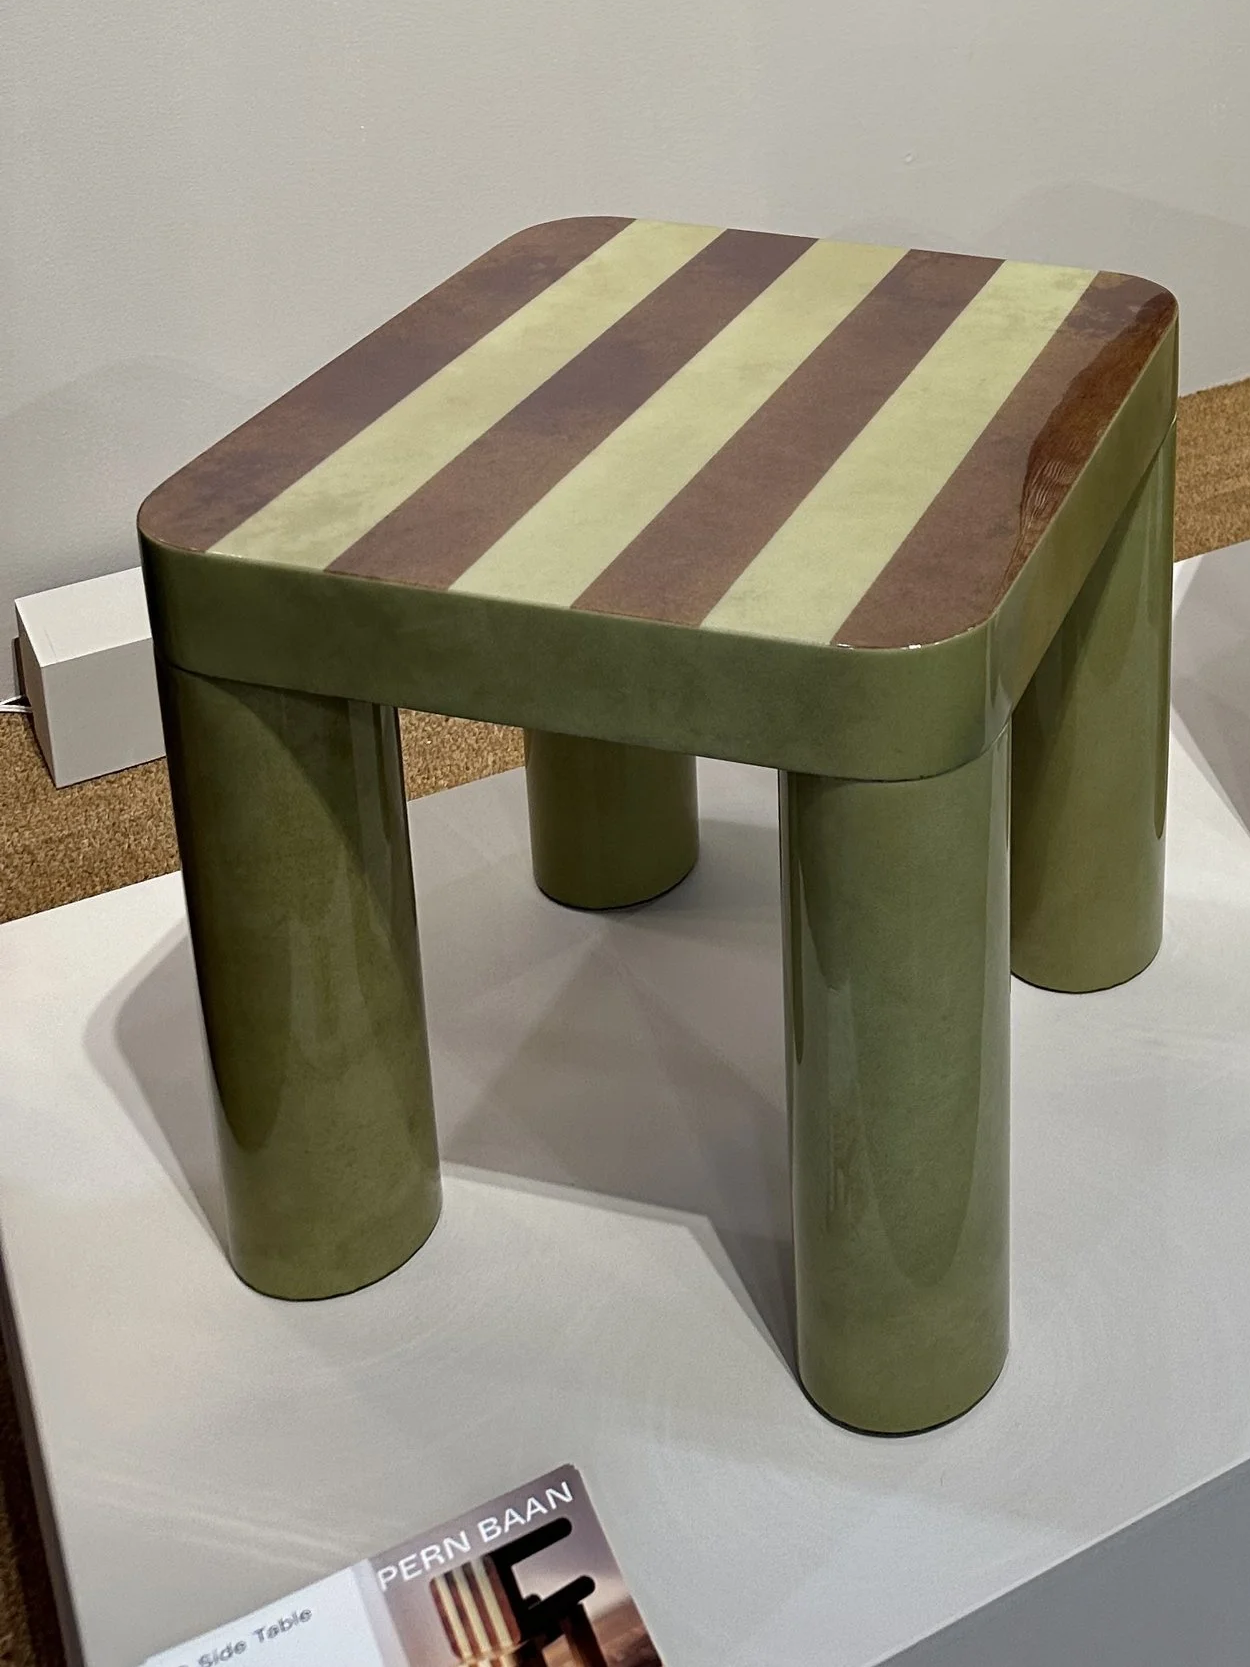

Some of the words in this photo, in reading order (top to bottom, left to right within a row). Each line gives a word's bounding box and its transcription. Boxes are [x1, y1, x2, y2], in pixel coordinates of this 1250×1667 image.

[376, 1530, 473, 1593] PERN
[478, 1480, 574, 1544] BAAN
[197, 1638, 248, 1667] Side
[252, 1607, 313, 1643] Table
